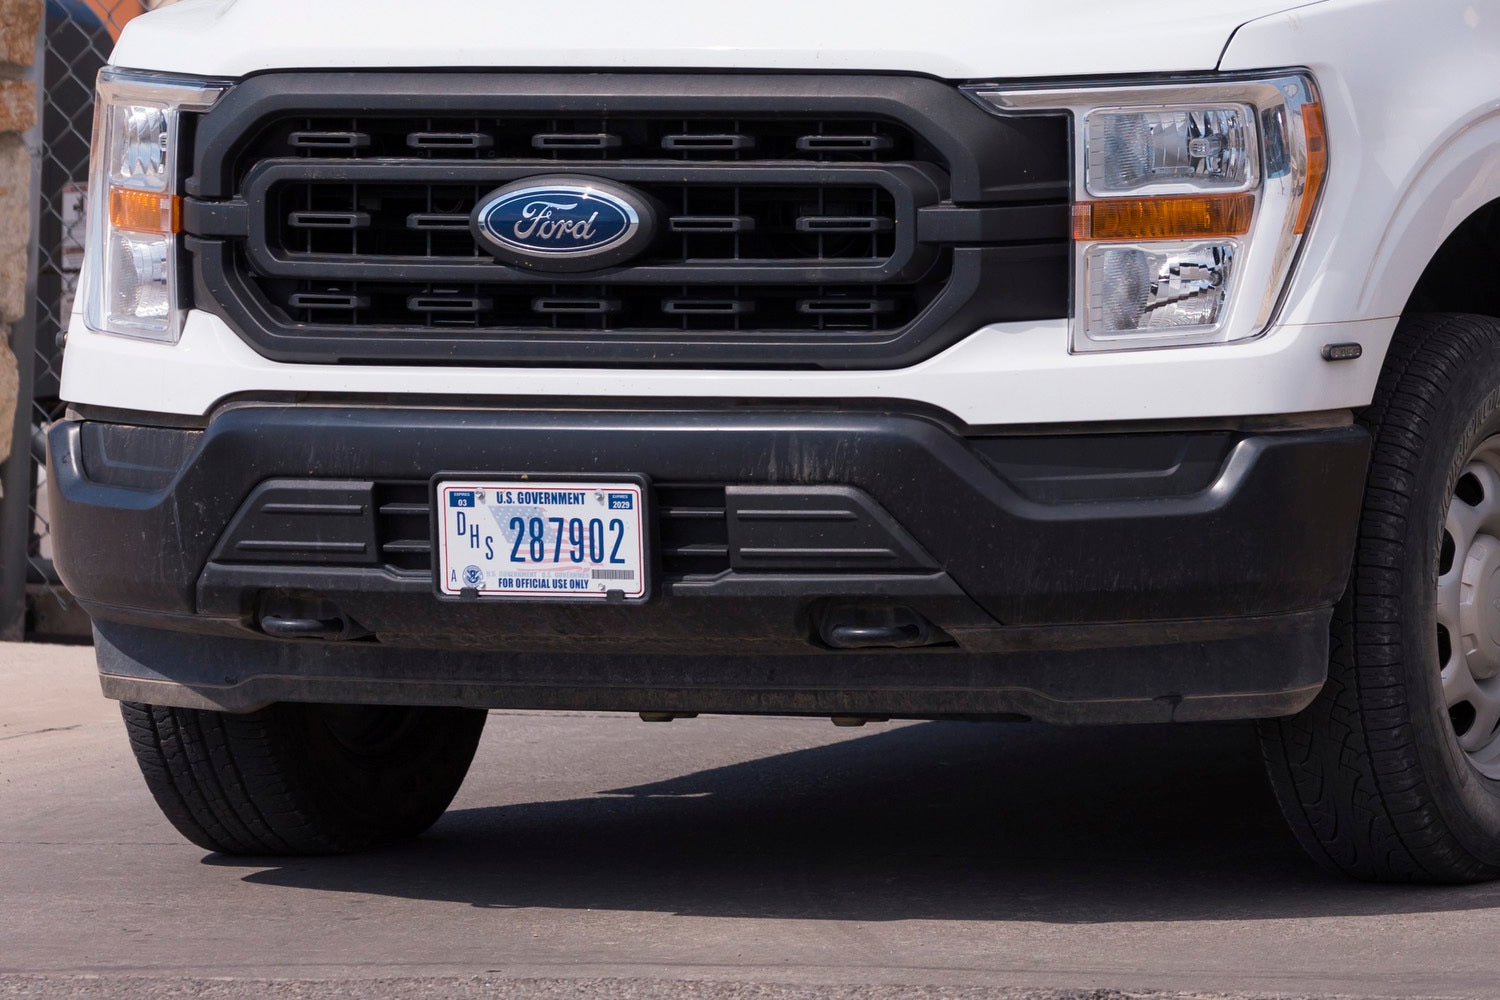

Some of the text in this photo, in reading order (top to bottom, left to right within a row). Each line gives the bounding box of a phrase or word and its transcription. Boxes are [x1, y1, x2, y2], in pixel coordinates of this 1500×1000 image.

[513, 201, 599, 240] Ford
[457, 498, 468, 507] 03
[496, 491, 586, 505] U.S. GOVERNMENT
[509, 517, 625, 564] 287902
[451, 569, 457, 582] A
[498, 578, 589, 589] FOR OFFICIAL USE ONLY
